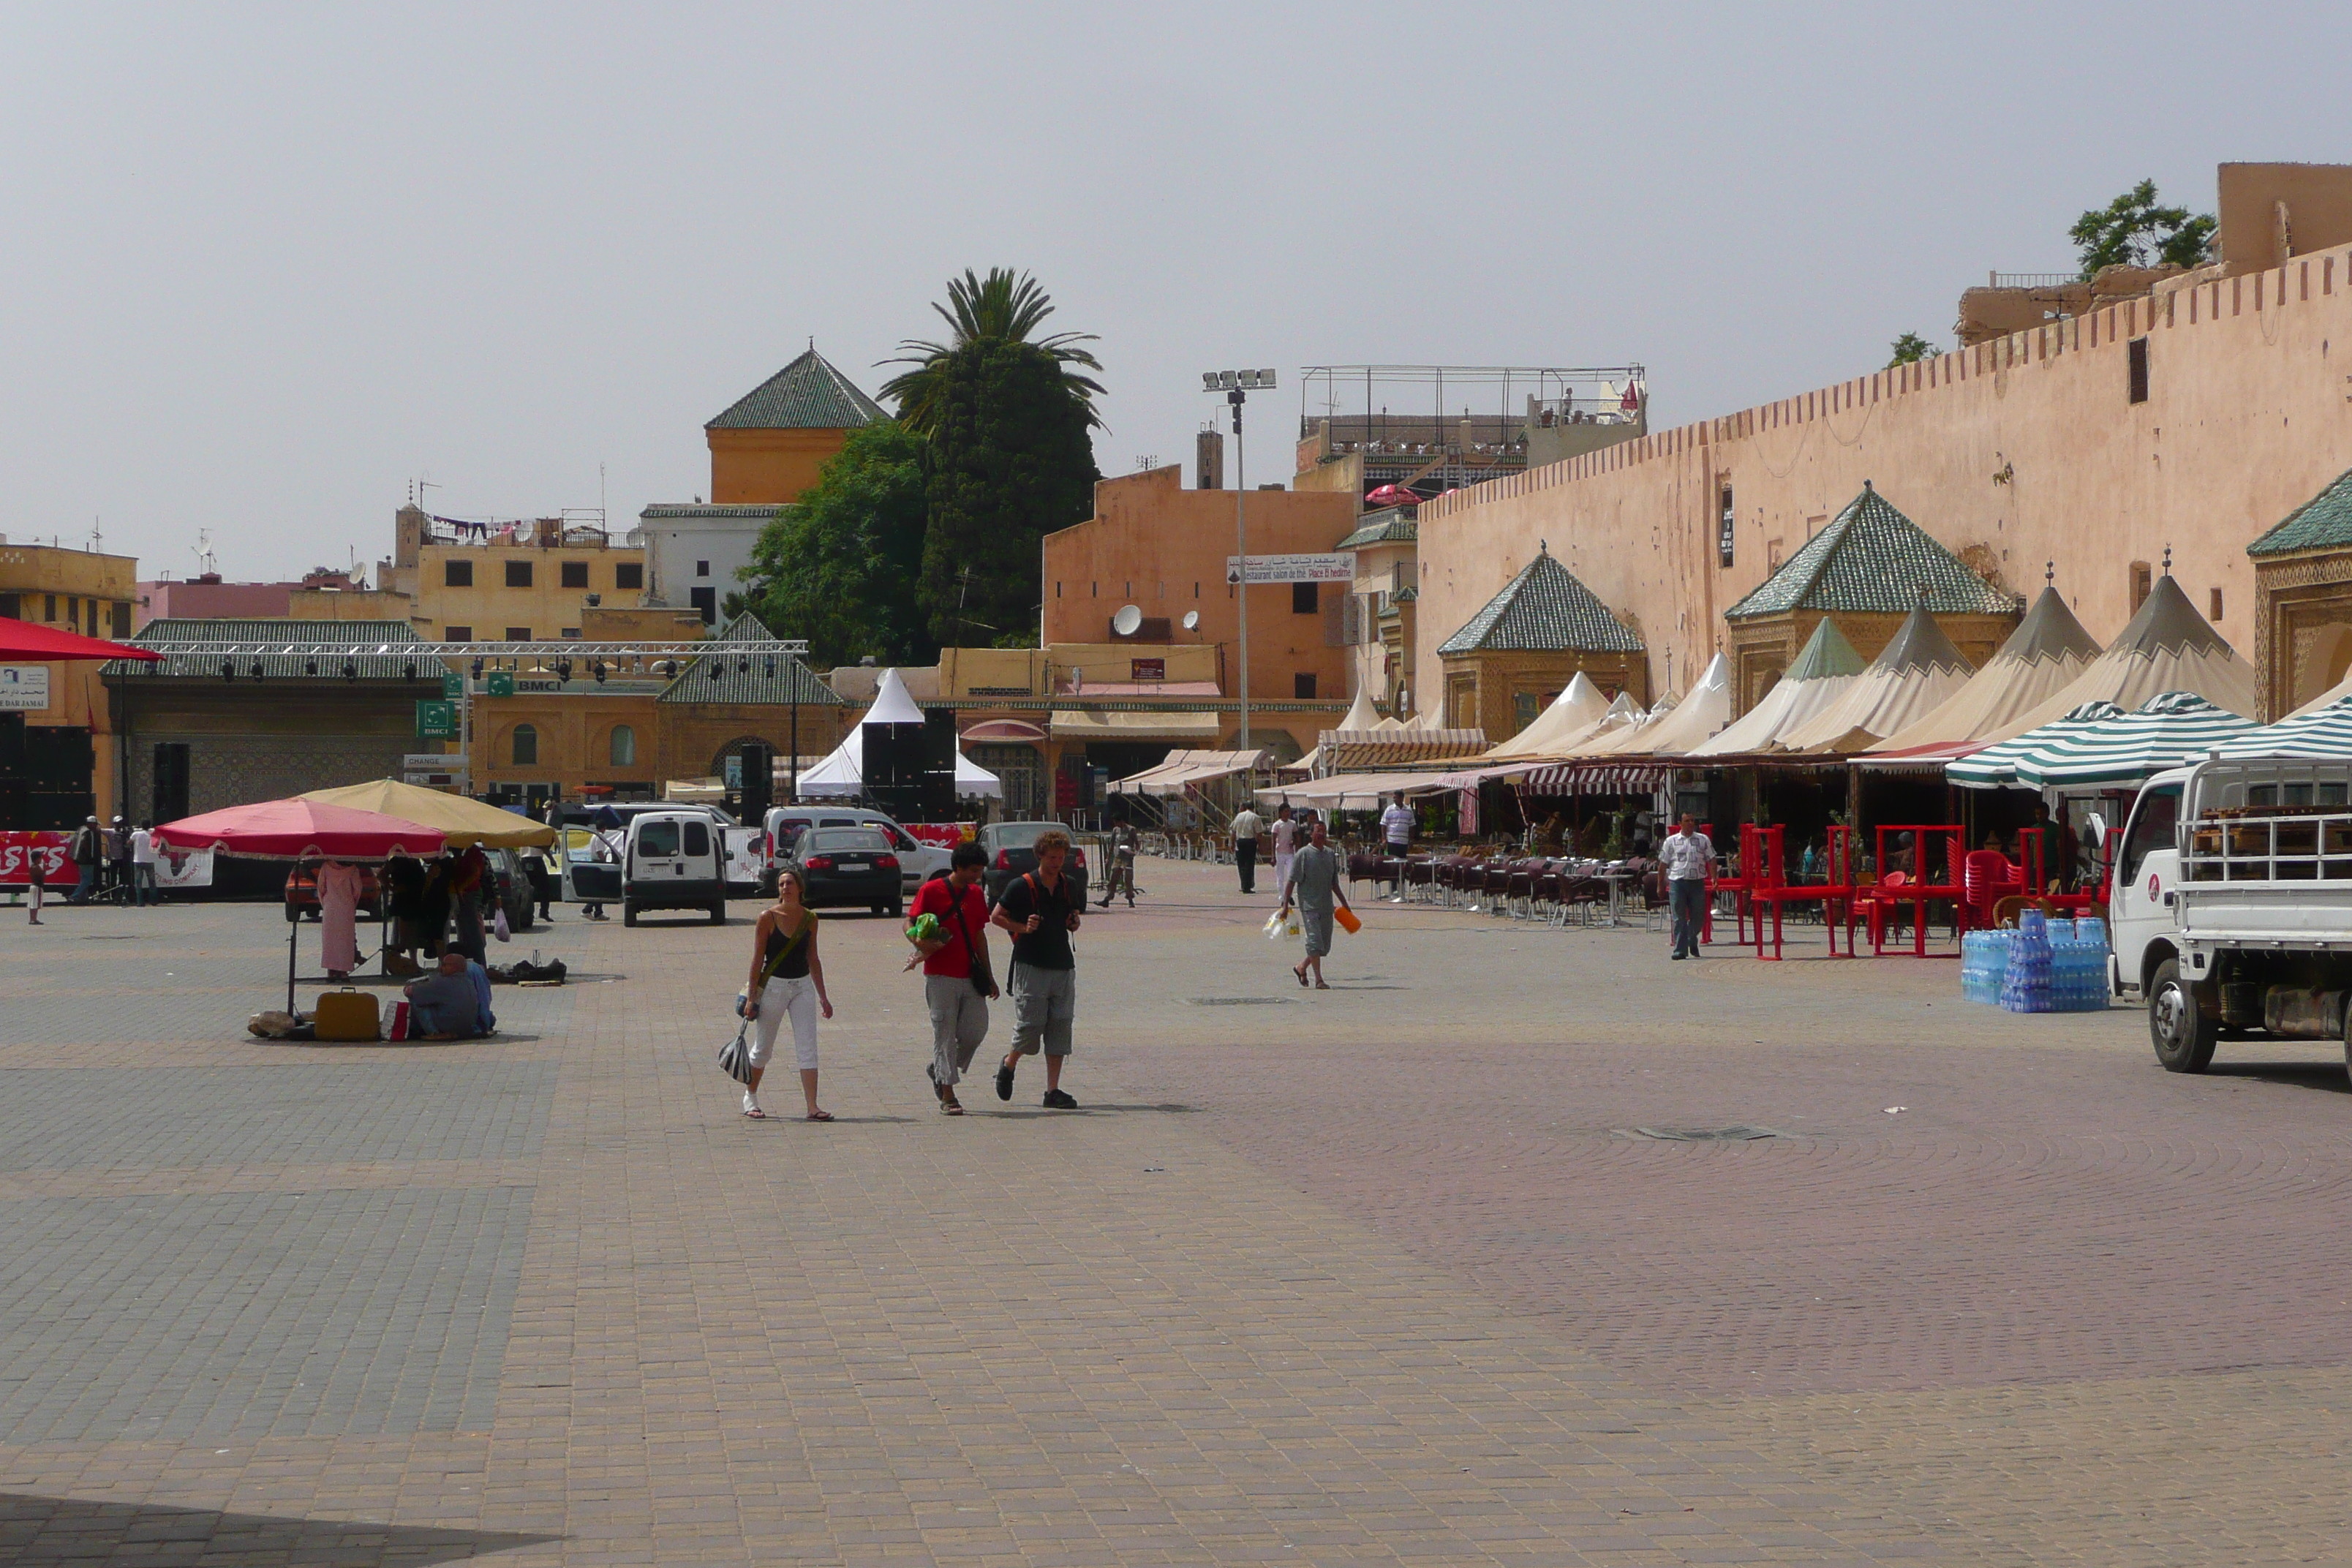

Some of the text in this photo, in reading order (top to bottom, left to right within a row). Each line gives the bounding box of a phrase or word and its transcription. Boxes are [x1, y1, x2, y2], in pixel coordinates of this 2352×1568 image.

[1244, 570, 1272, 580] estaurant
[1273, 570, 1287, 578] salon
[1308, 568, 1324, 578] Place
[519, 681, 561, 691] BMCI
[174, 863, 200, 885] COMPANY
